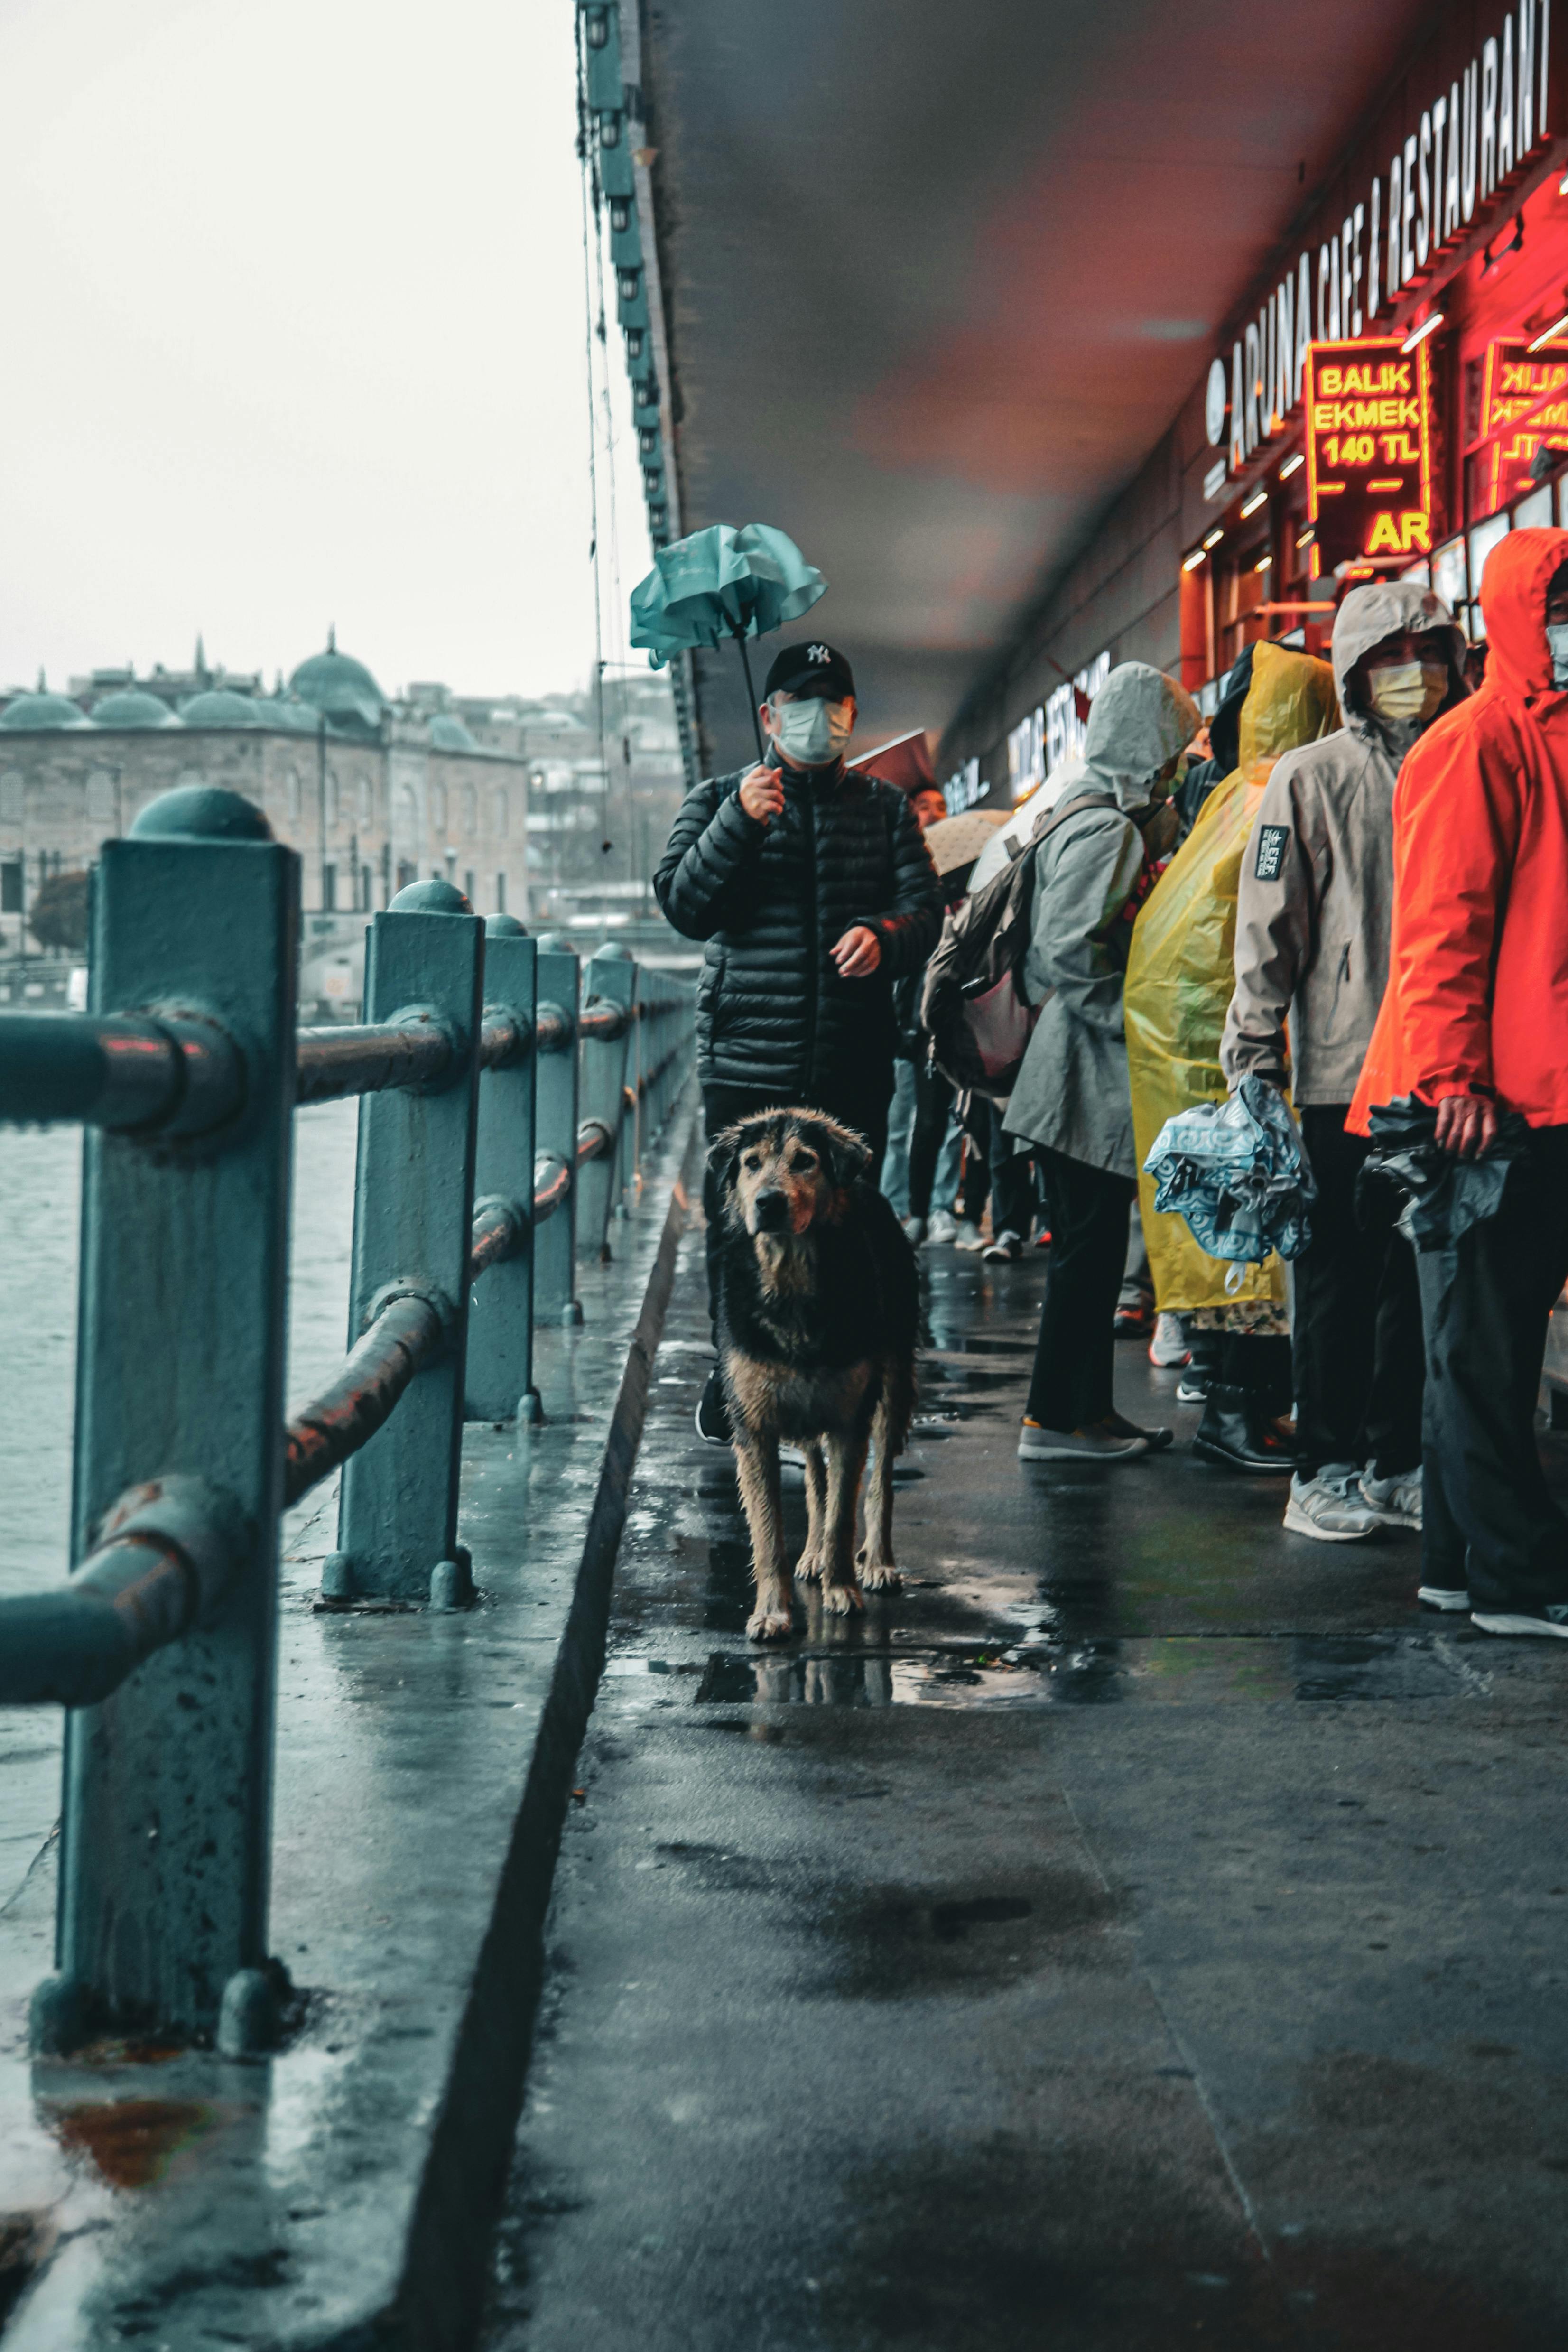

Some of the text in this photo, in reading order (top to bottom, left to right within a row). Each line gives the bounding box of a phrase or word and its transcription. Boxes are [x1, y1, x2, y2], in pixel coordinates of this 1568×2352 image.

[1317, 203, 1364, 341] CAFE
[1321, 363, 1411, 395] BALIK
[1314, 398, 1420, 429] EKMEK
[1325, 433, 1420, 465] 140 TL
[1367, 512, 1431, 553] AR
